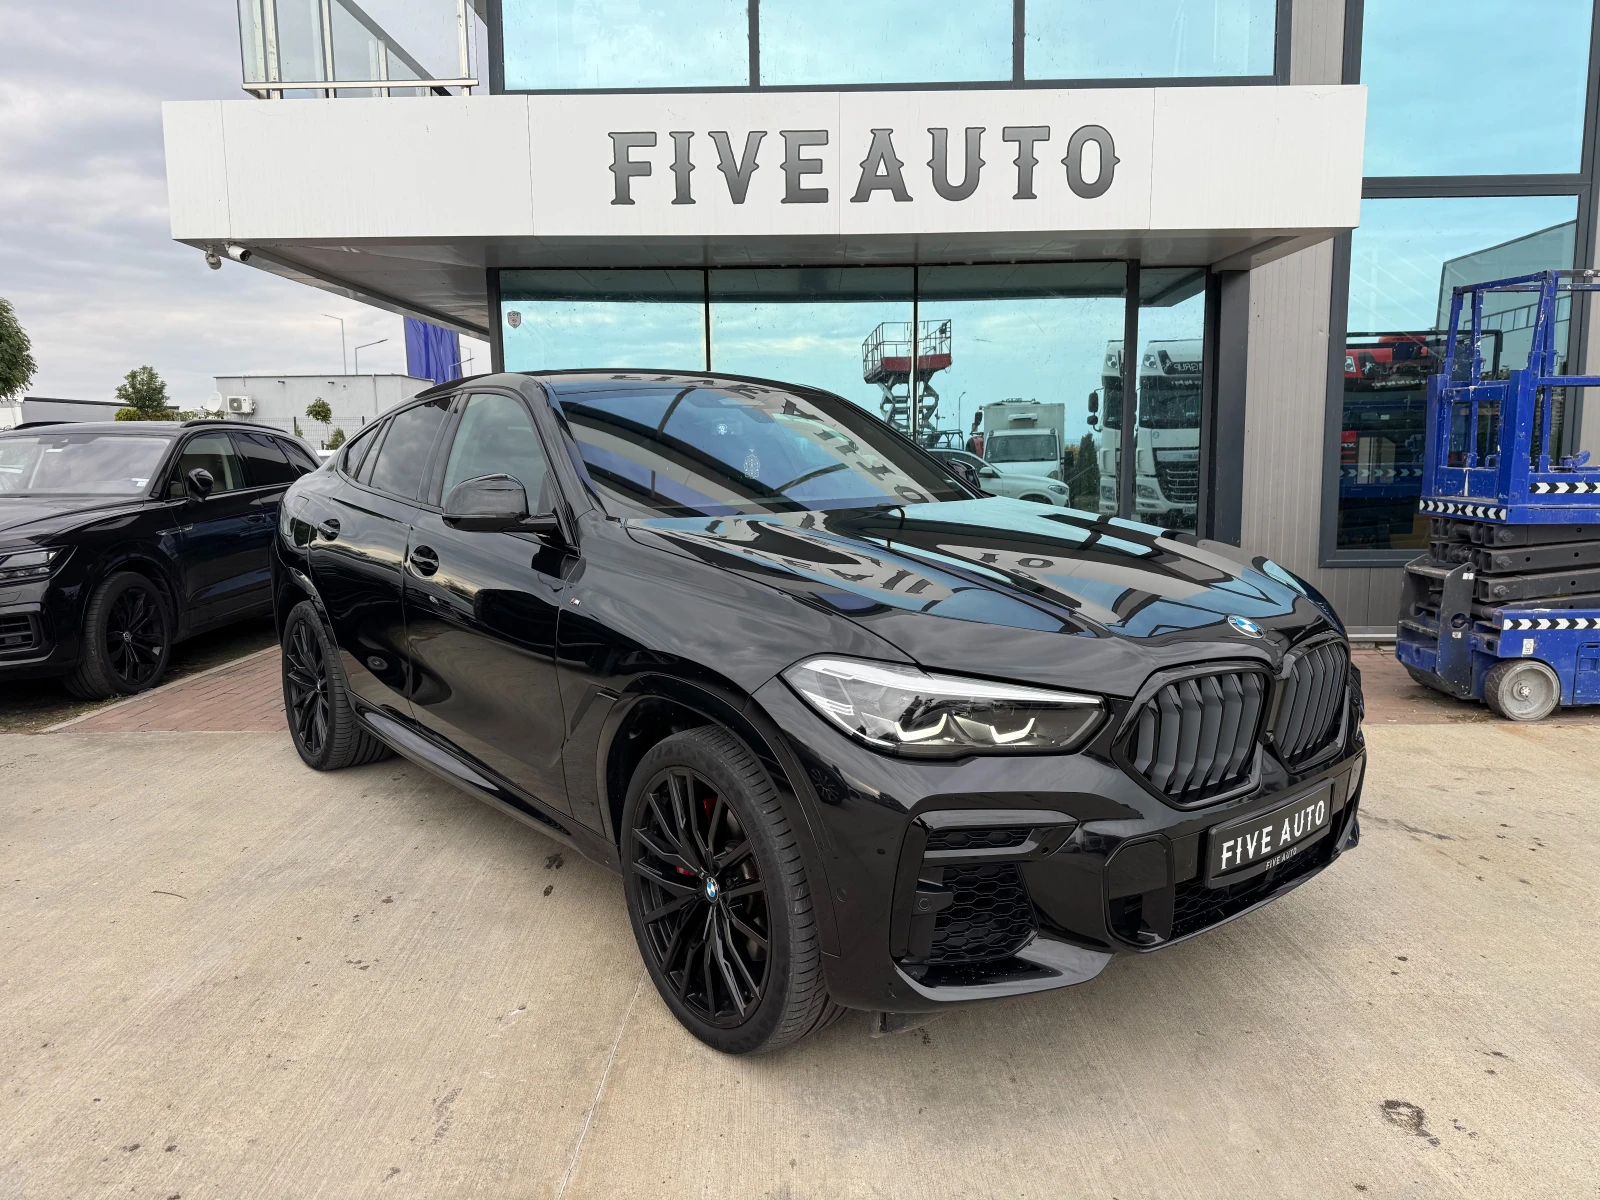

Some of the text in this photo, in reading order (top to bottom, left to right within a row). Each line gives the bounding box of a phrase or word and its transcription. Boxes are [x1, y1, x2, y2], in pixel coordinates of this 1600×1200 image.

[1220, 800, 1325, 870] FIVE AUTO
[1265, 847, 1297, 870] FIVE AUTO
